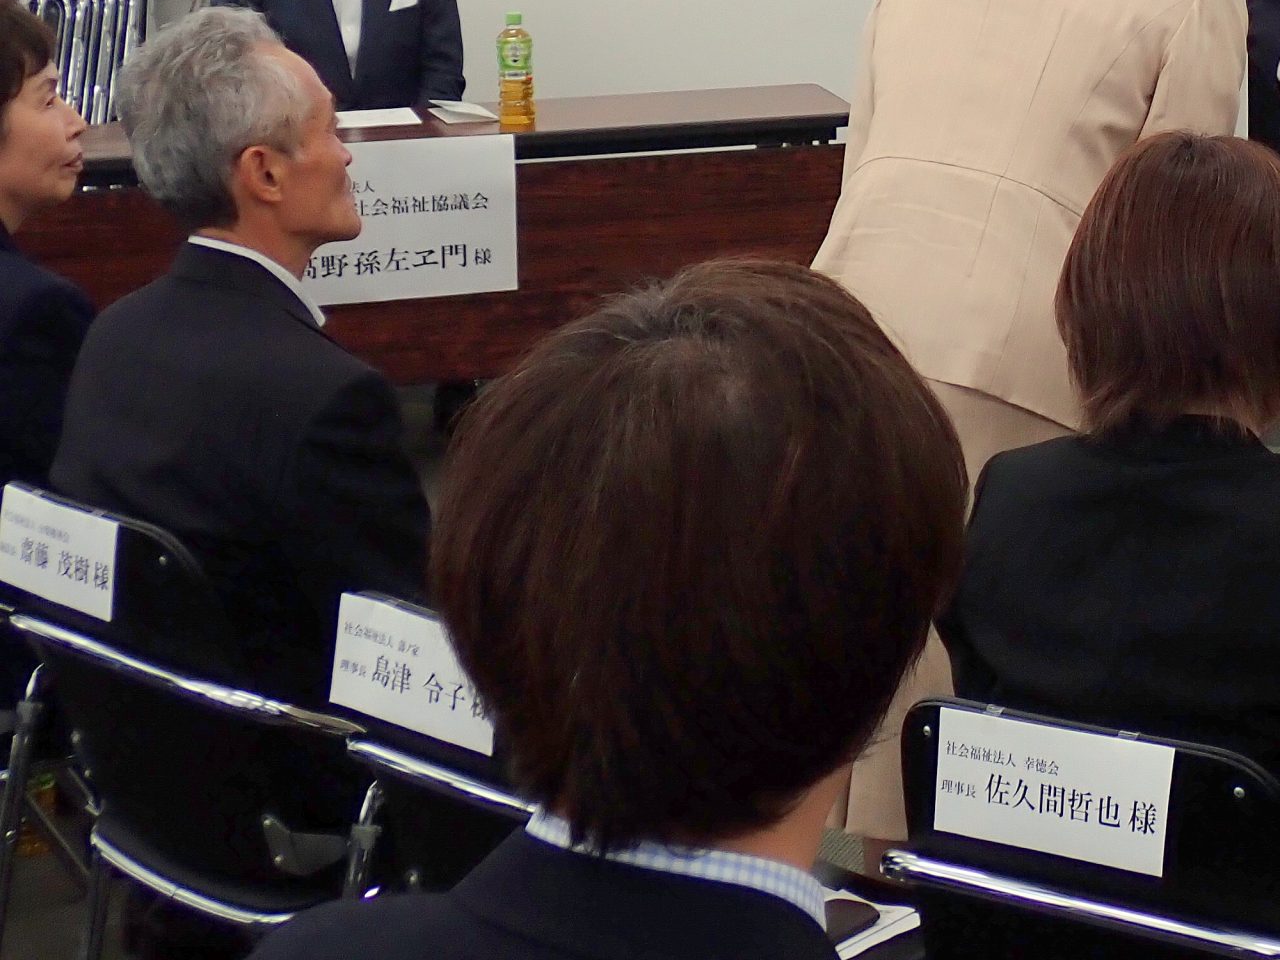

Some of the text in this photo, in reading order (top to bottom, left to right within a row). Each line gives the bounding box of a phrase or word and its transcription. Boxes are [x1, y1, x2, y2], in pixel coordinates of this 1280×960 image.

[372, 655, 411, 694] 島津
[423, 672, 465, 711] 令子
[945, 740, 1016, 767] 社会福祉法人
[941, 773, 1158, 835] 理事長 佐久間哲也 様
